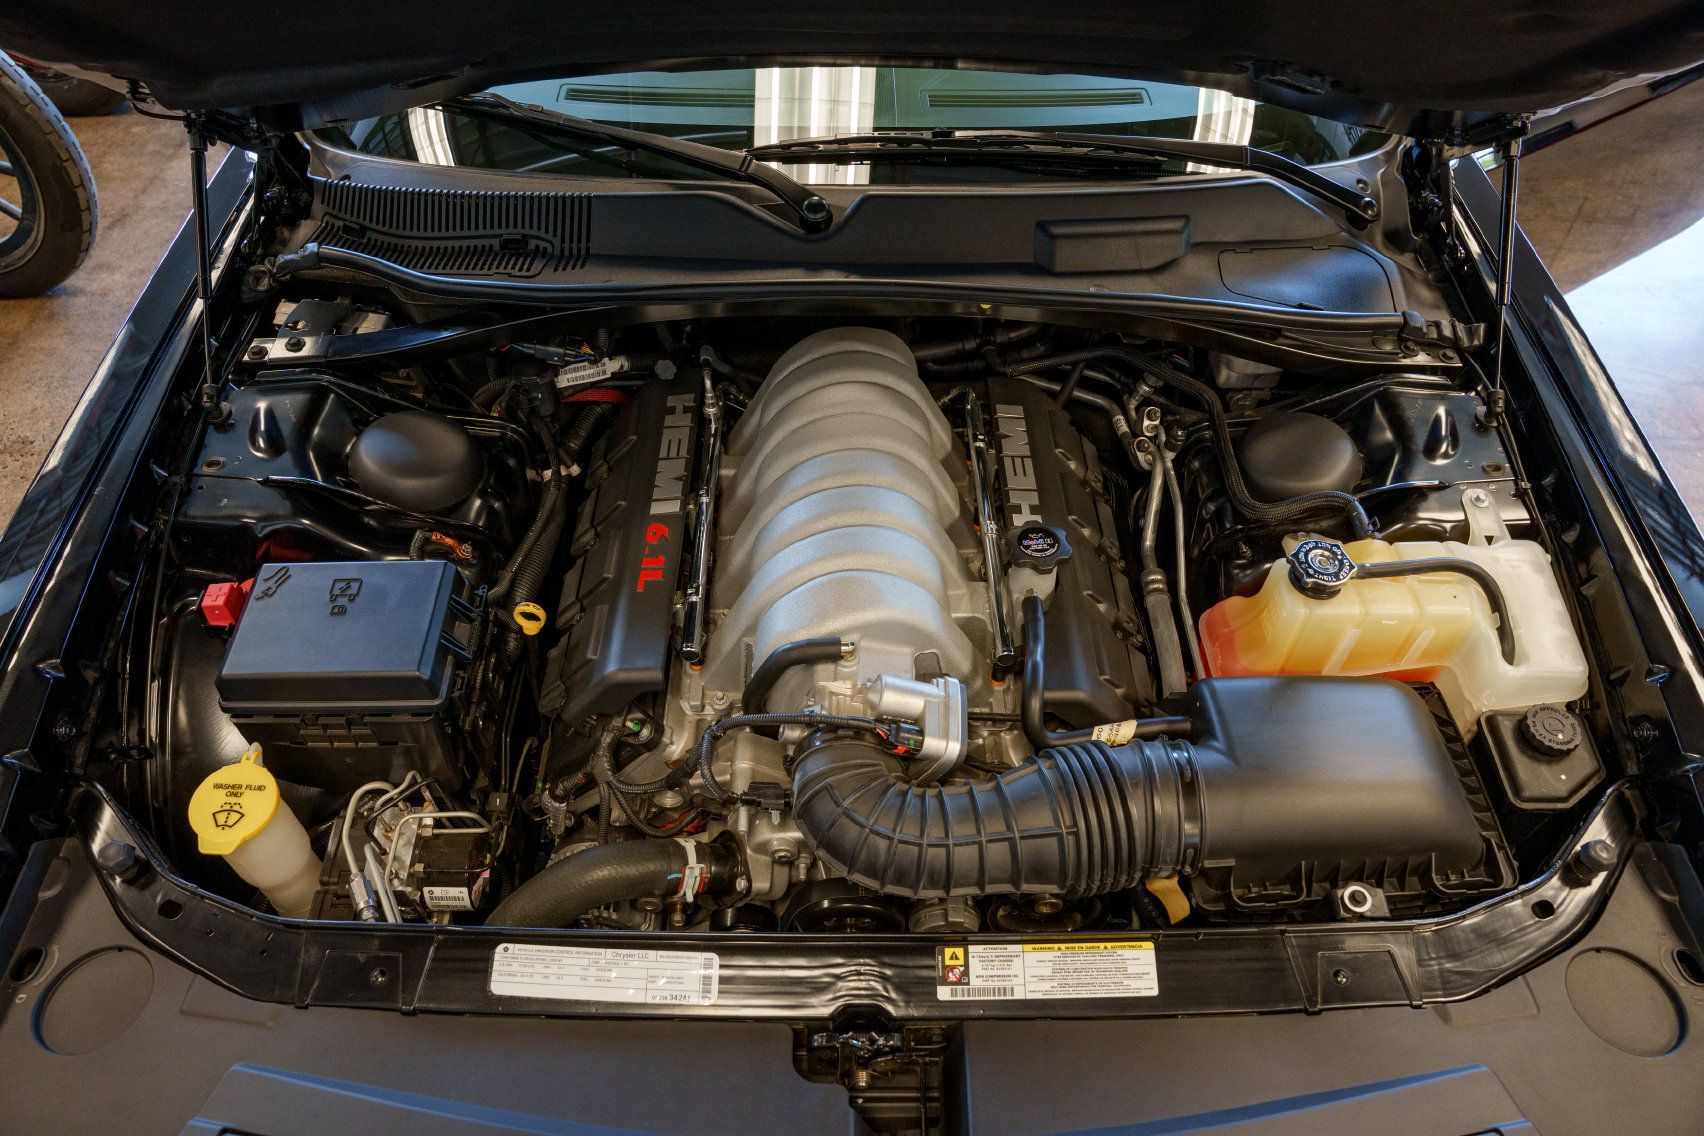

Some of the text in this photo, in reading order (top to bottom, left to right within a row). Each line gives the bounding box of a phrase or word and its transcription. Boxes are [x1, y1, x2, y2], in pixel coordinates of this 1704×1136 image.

[650, 394, 696, 514] HEMI
[995, 404, 1042, 527] HEMI
[633, 523, 669, 592] 6.1L
[213, 783, 243, 791] WASHER
[611, 951, 637, 960] Chrysler
